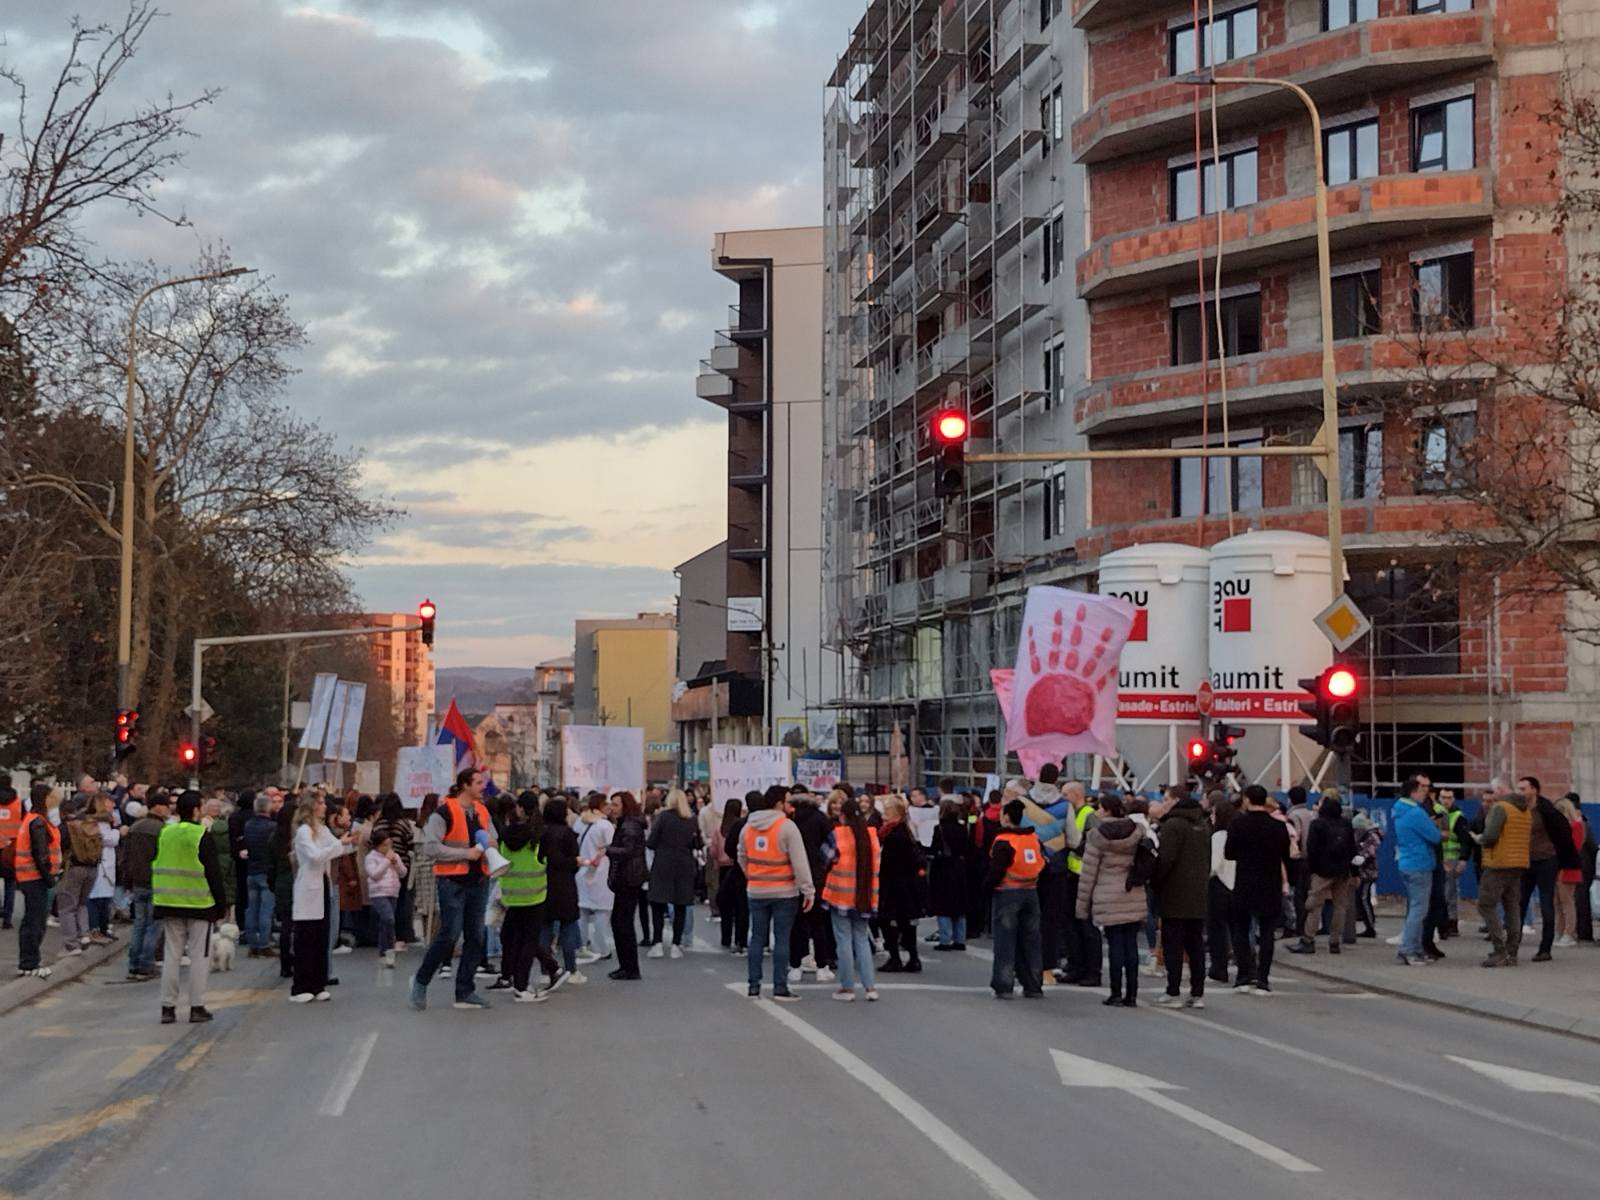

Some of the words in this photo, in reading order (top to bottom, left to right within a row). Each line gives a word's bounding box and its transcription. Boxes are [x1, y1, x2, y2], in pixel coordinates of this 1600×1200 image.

[1118, 665, 1180, 688] umit
[1211, 665, 1284, 690] aumit
[1263, 698, 1299, 713] Estri
